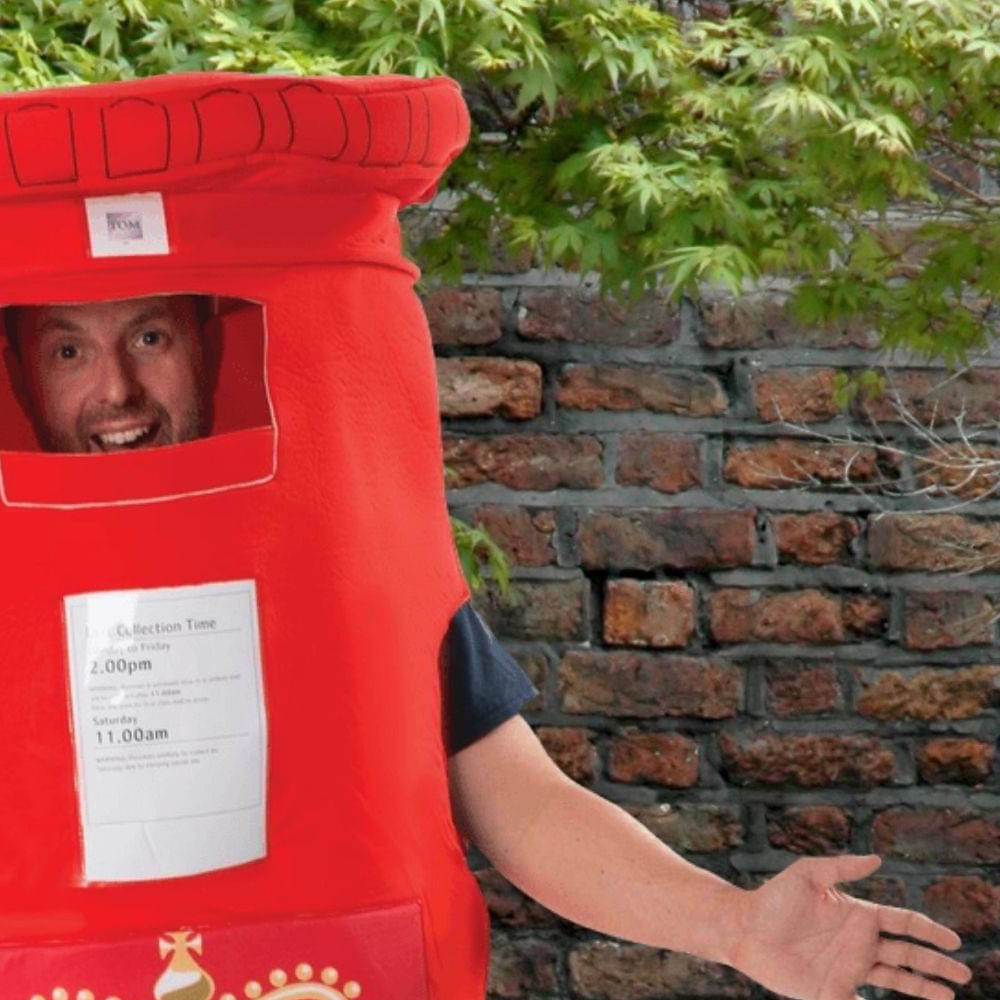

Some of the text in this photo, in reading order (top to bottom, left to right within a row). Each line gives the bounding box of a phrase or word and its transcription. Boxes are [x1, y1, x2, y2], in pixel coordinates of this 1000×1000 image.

[186, 618, 217, 631] Time
[140, 641, 171, 653] Friday
[91, 658, 152, 675] 2.00pm
[92, 715, 138, 727] Saturday
[97, 728, 168, 744] 11.00am
